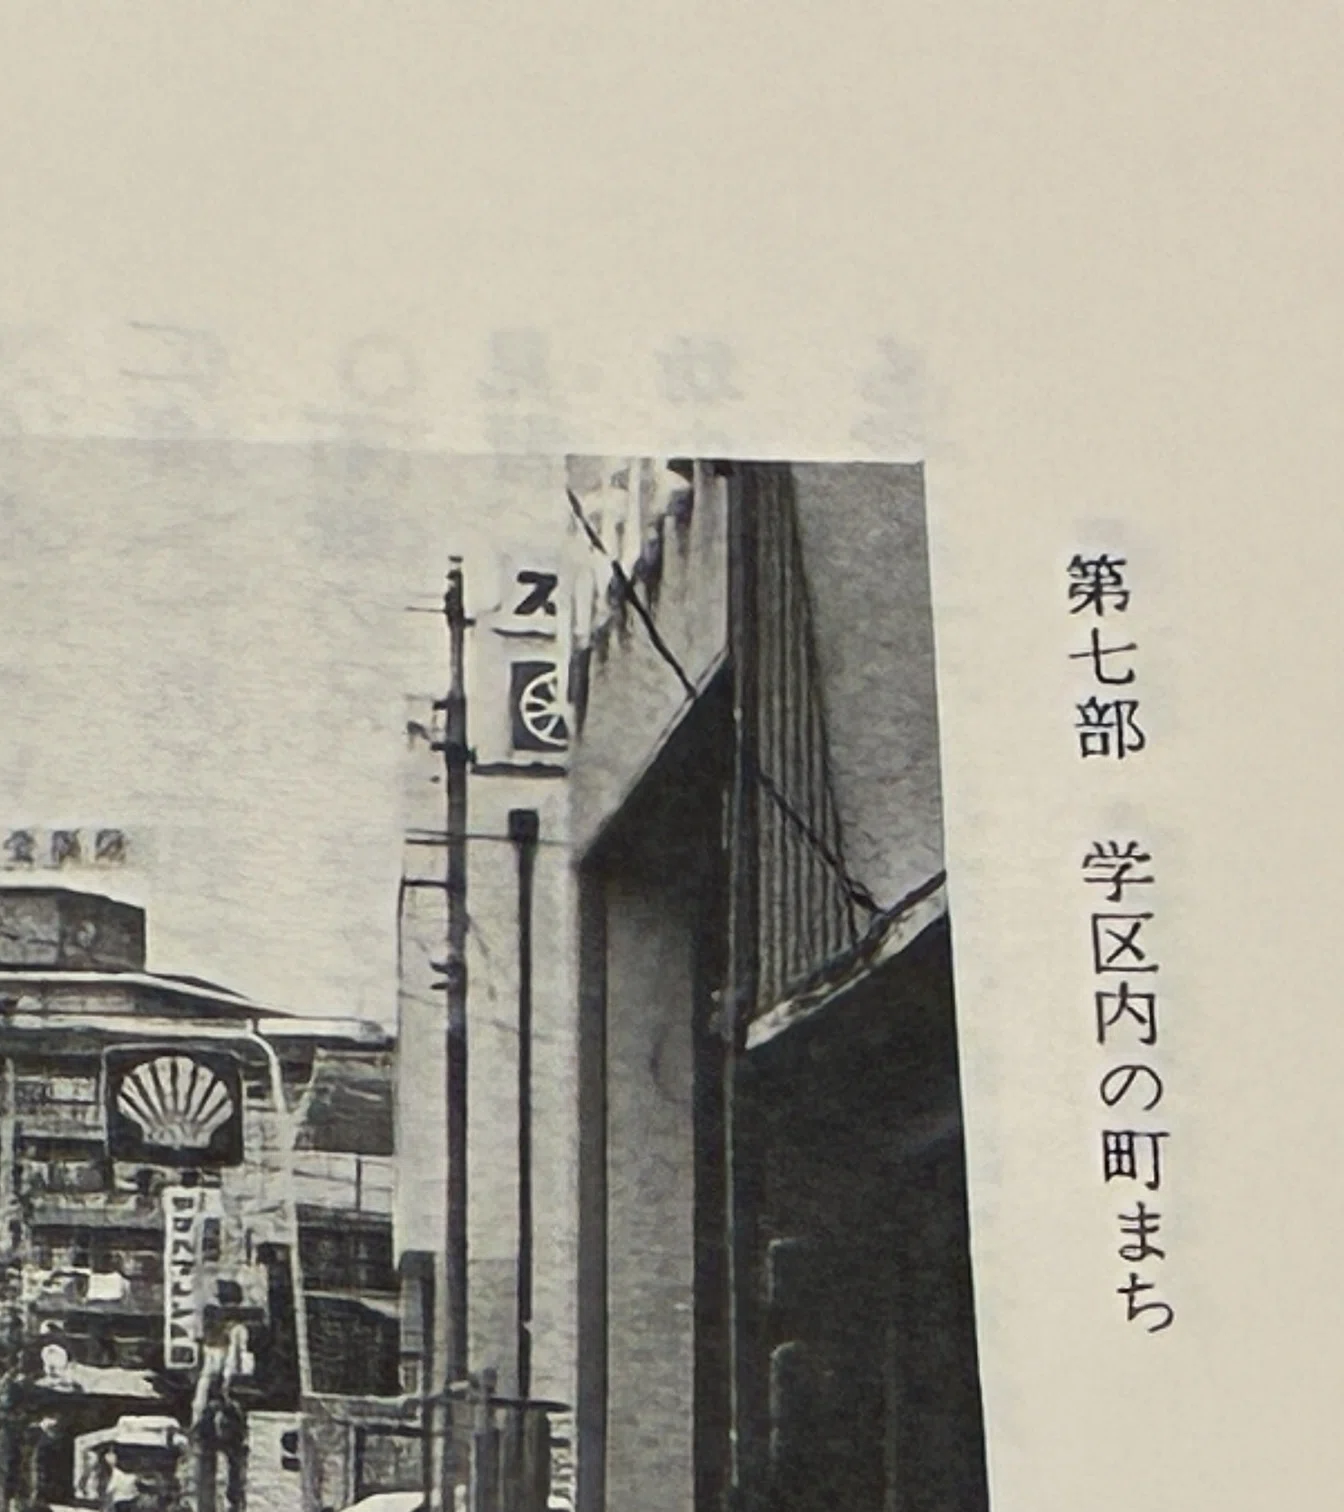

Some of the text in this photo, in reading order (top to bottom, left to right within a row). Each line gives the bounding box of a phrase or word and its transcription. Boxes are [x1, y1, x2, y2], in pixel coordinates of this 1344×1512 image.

[1067, 553, 1175, 1334] 第七部 学区内の町まち
